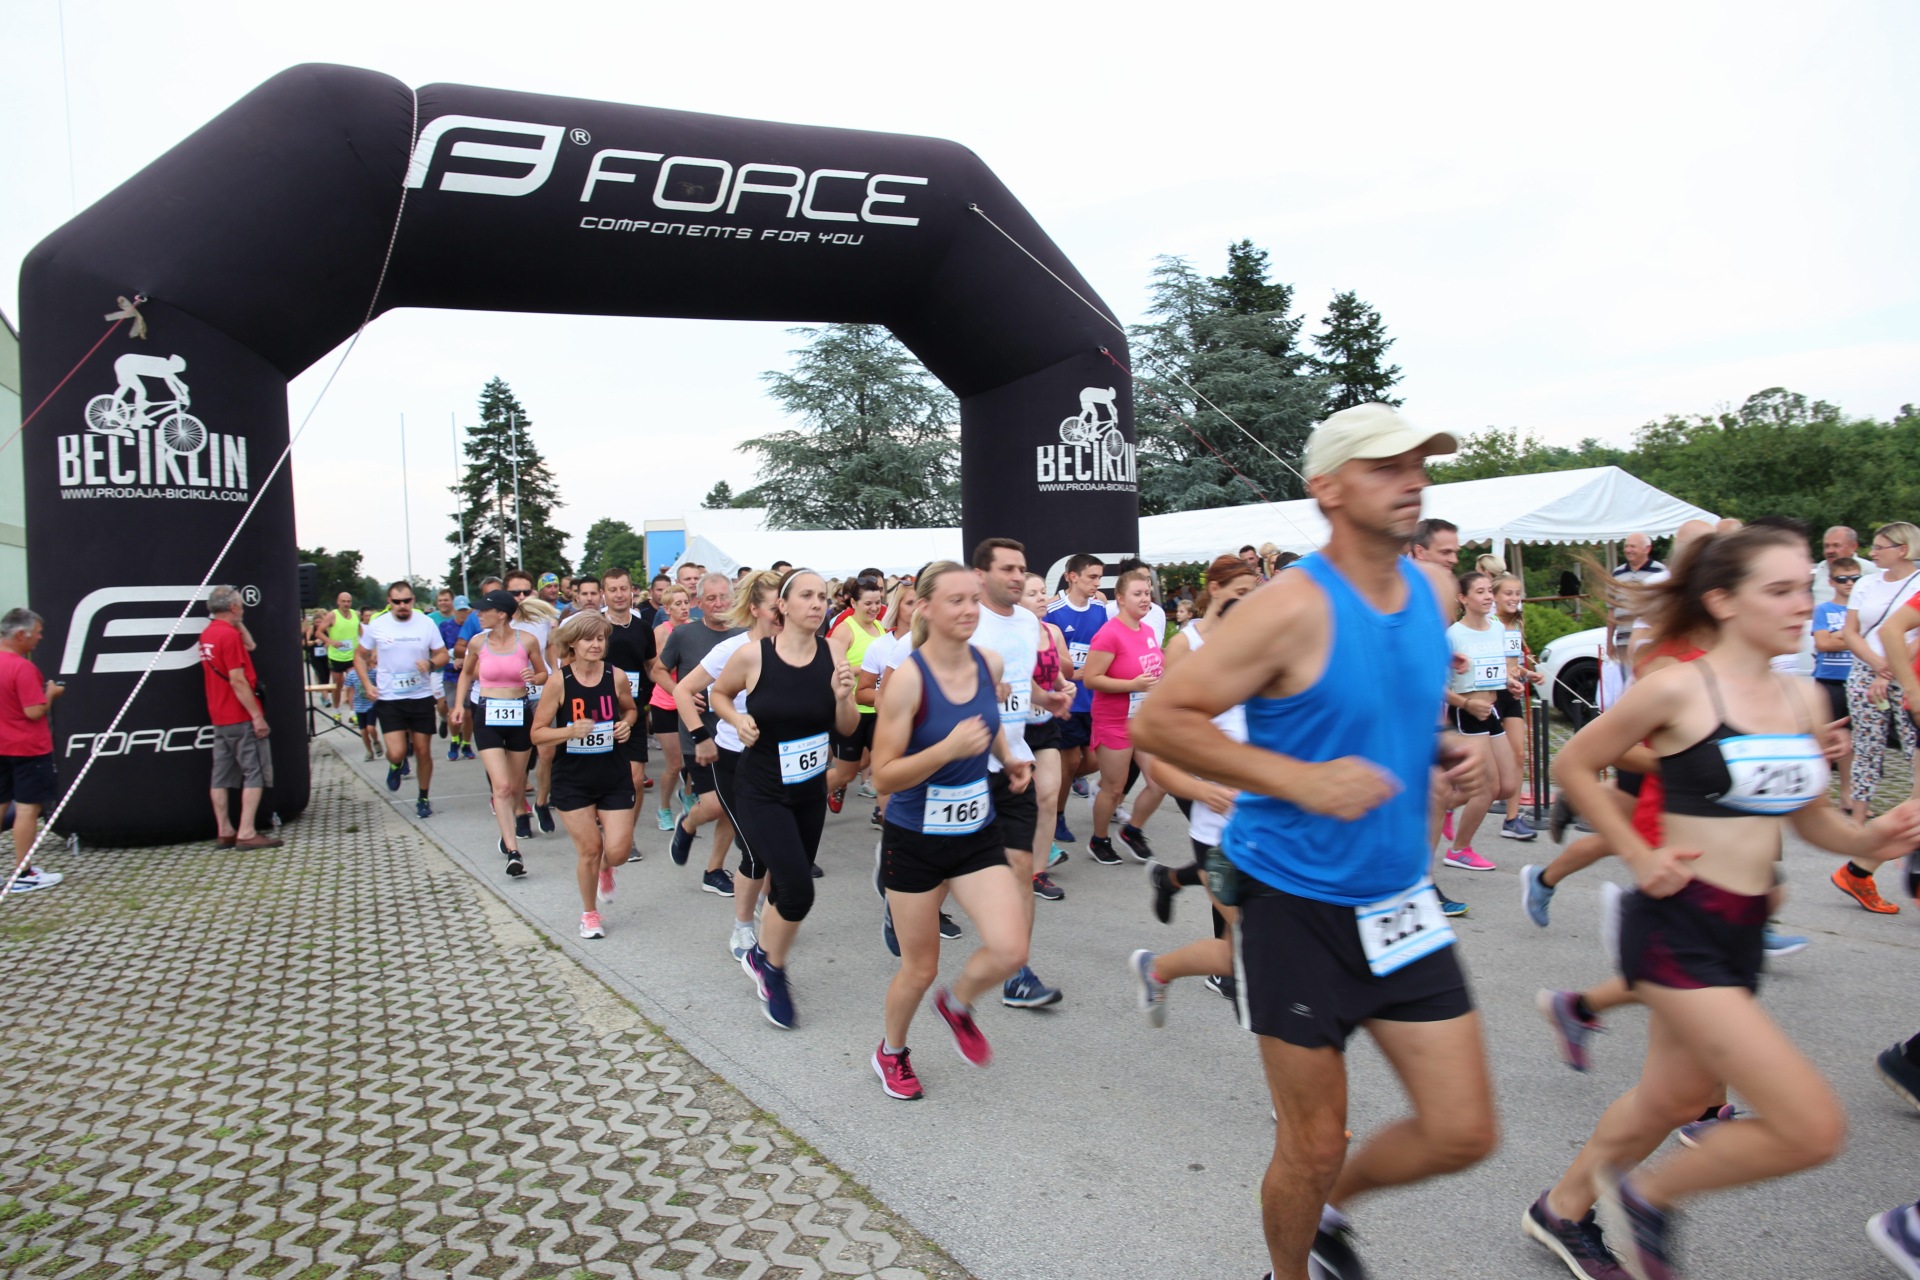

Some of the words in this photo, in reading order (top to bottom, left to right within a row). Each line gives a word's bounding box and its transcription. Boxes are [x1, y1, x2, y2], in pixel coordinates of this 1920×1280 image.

[579, 148, 928, 227] FORCE
[579, 216, 753, 240] COMPONENTS
[760, 229, 811, 243] FOR
[818, 232, 865, 246] YOU
[60, 487, 249, 503] WWW.PRODAJA-BICIKLA.COM
[1486, 666, 1499, 679] 67
[398, 677, 417, 688] 115
[494, 708, 516, 719] 131
[65, 724, 215, 758] FORCE
[578, 733, 605, 747] 185
[799, 750, 818, 771] 65
[942, 800, 979, 823] 166
